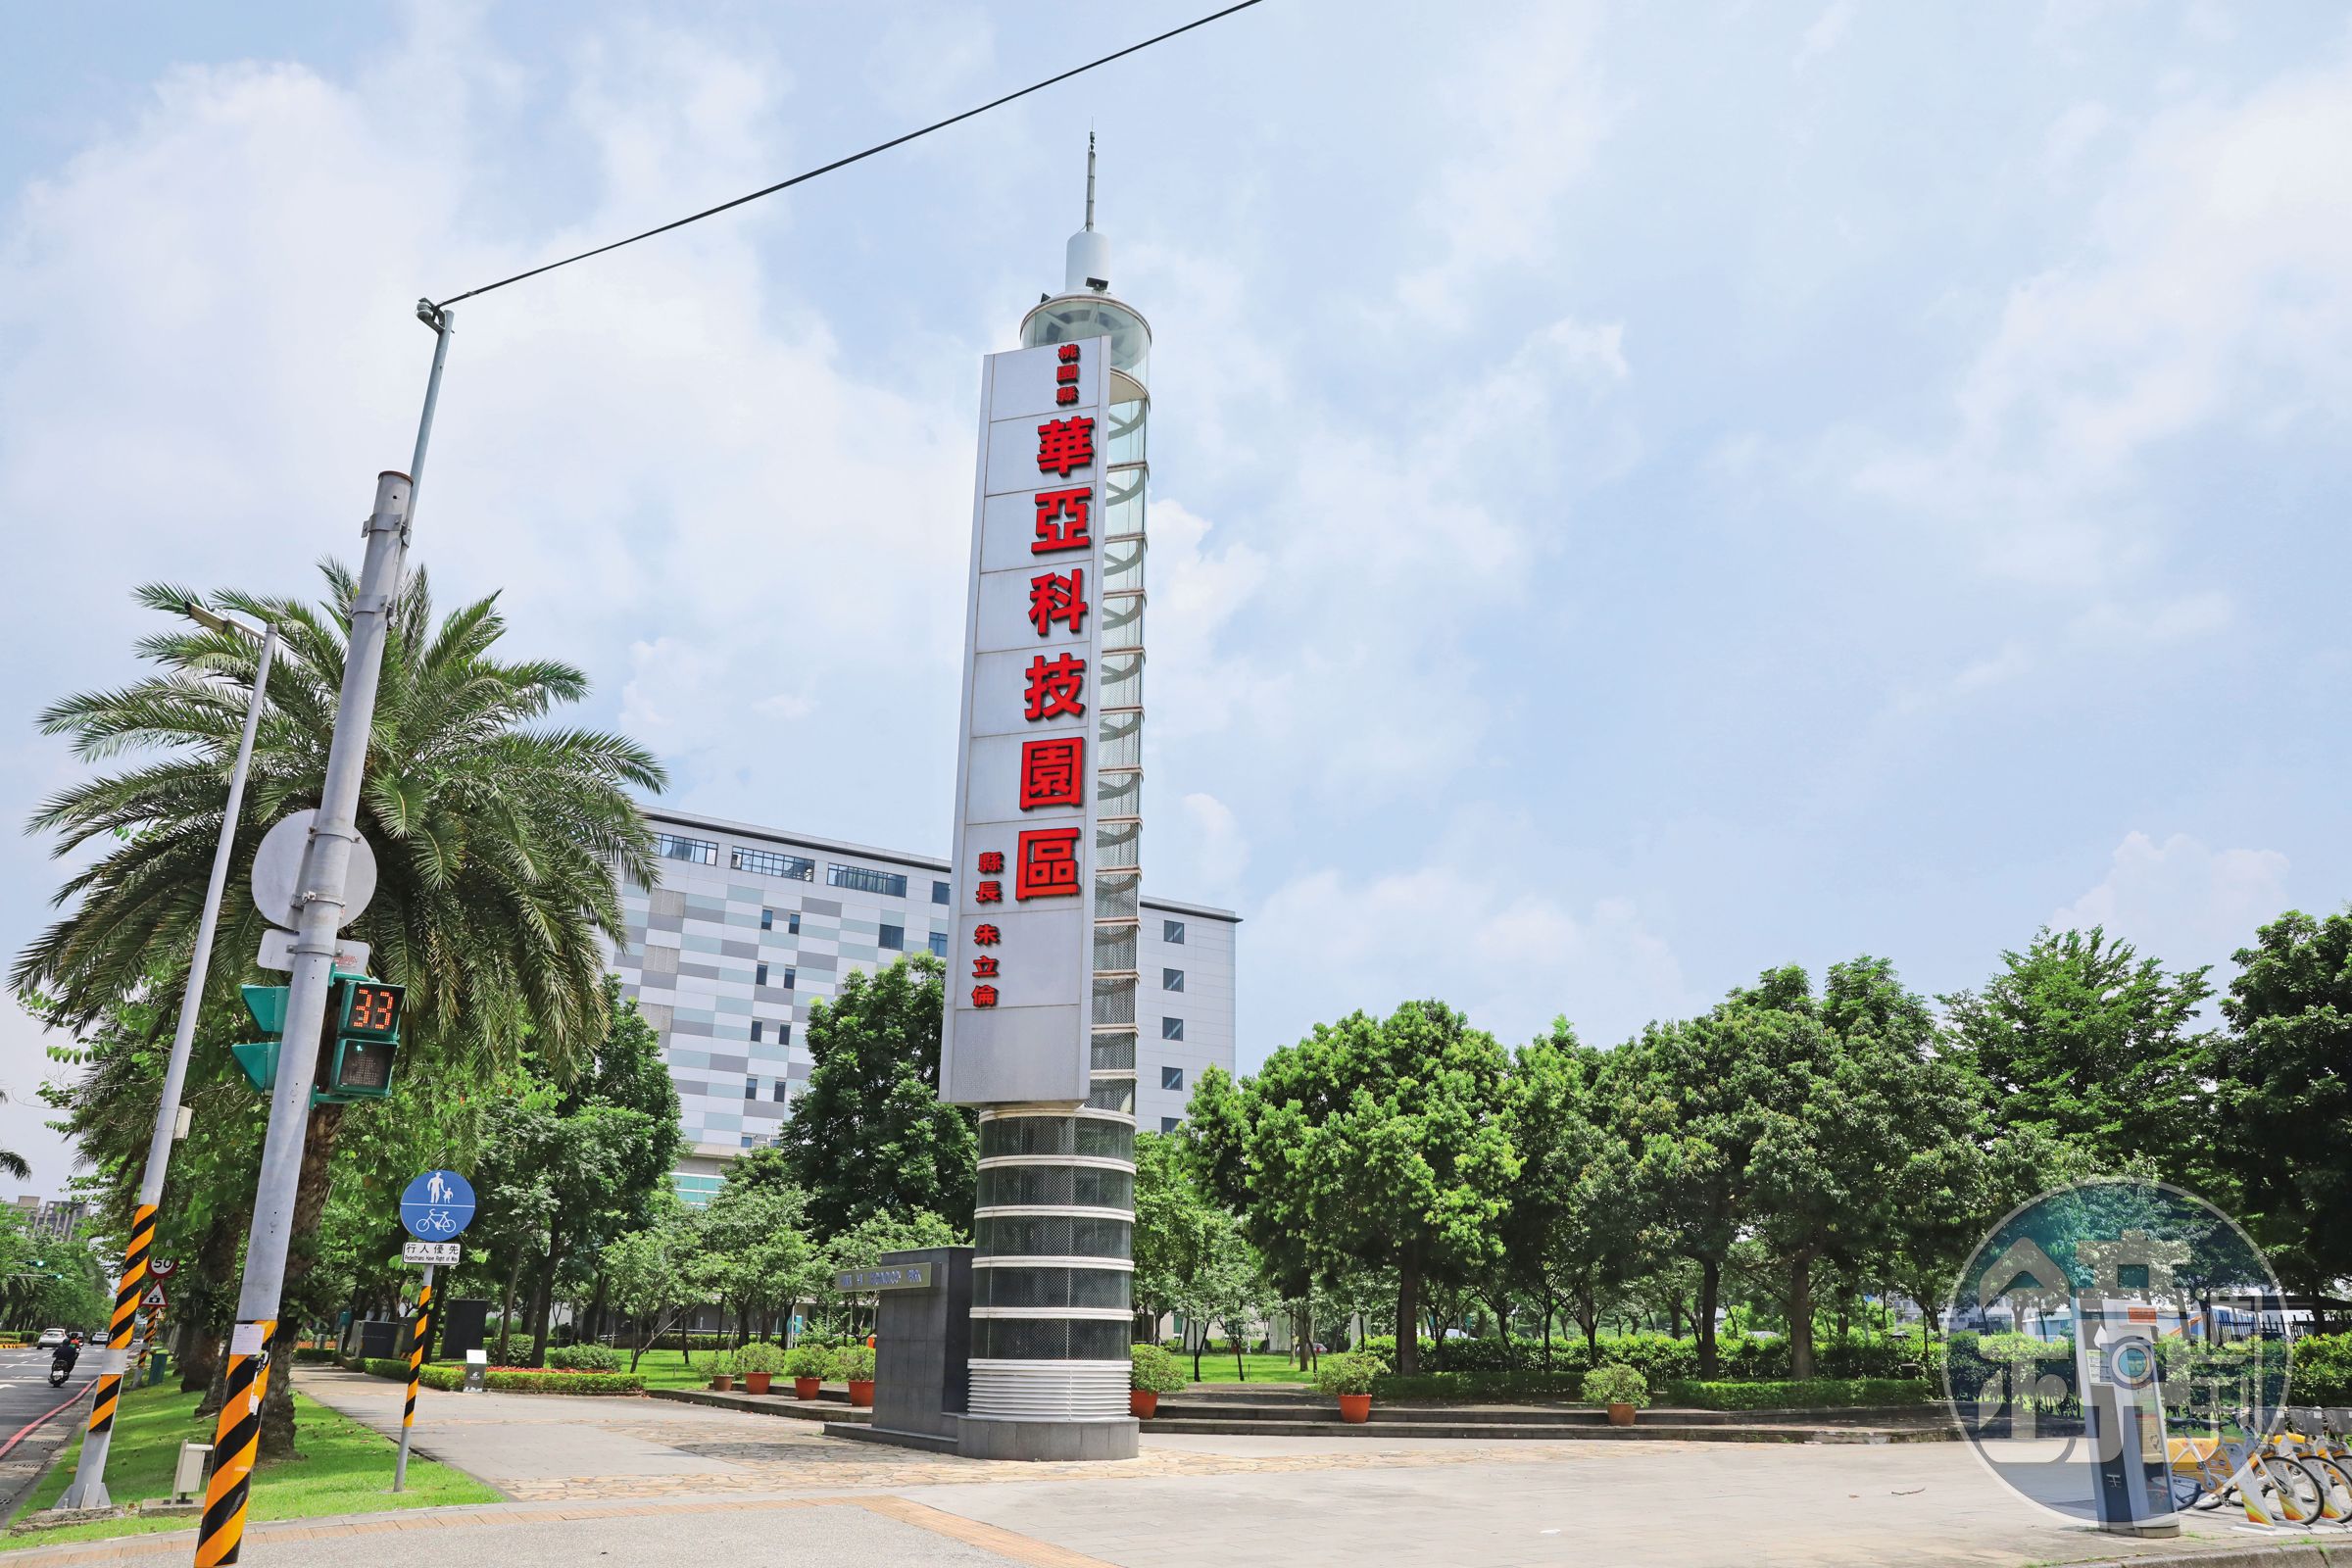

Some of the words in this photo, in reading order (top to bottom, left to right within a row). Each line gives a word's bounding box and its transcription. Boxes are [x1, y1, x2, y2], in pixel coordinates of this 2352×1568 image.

[1056, 343, 1080, 405] 桃園縣
[1015, 416, 1095, 902] 華亞科技園區
[976, 852, 1004, 903] 縣長
[971, 924, 1000, 1007] 朱立倫
[354, 989, 393, 1029] 33
[154, 1257, 172, 1268] 50
[407, 1244, 459, 1254] 行人優先
